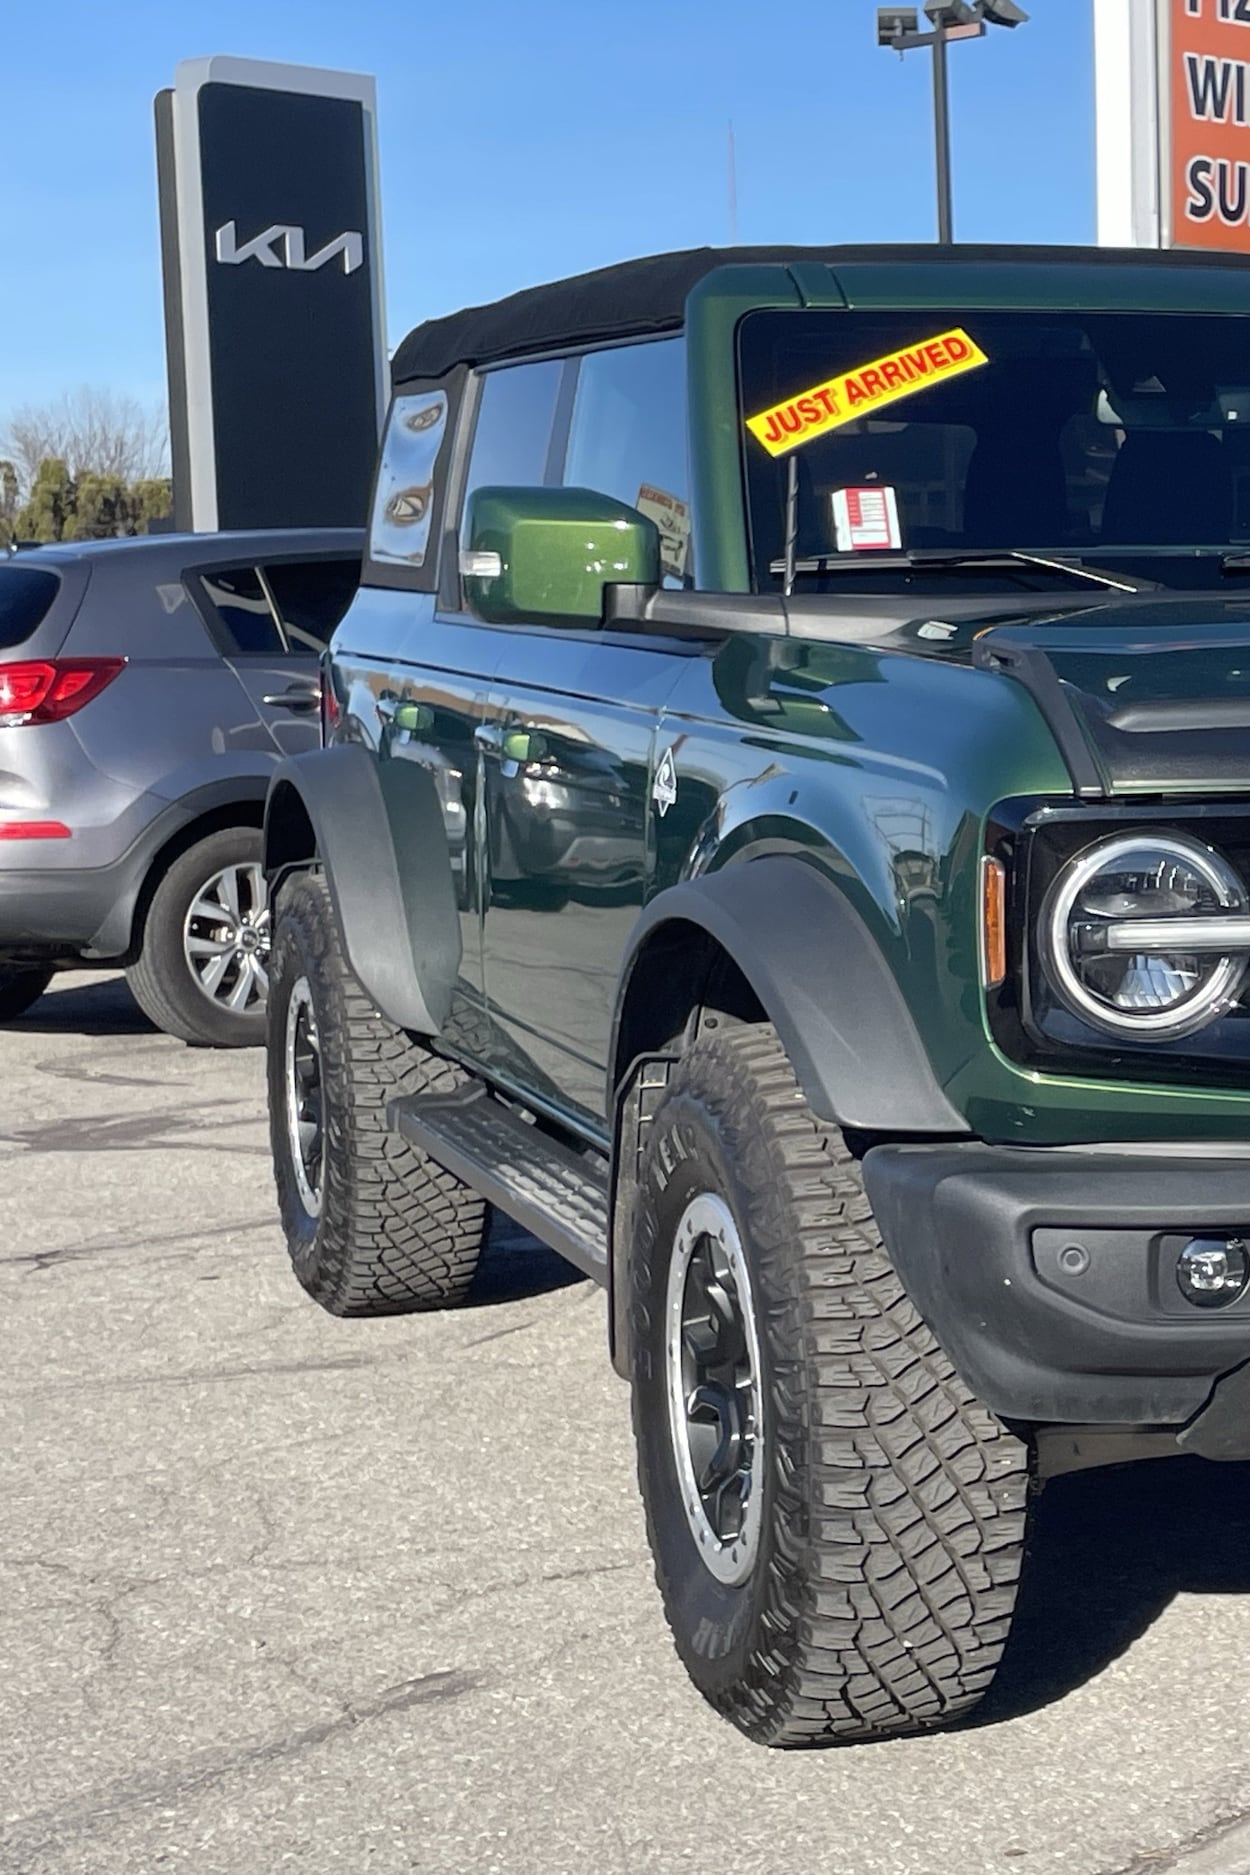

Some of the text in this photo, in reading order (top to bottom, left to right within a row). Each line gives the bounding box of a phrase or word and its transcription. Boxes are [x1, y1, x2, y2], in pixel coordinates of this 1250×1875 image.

[215, 220, 363, 275] KIA
[764, 336, 969, 443] JUST ARRIVED
